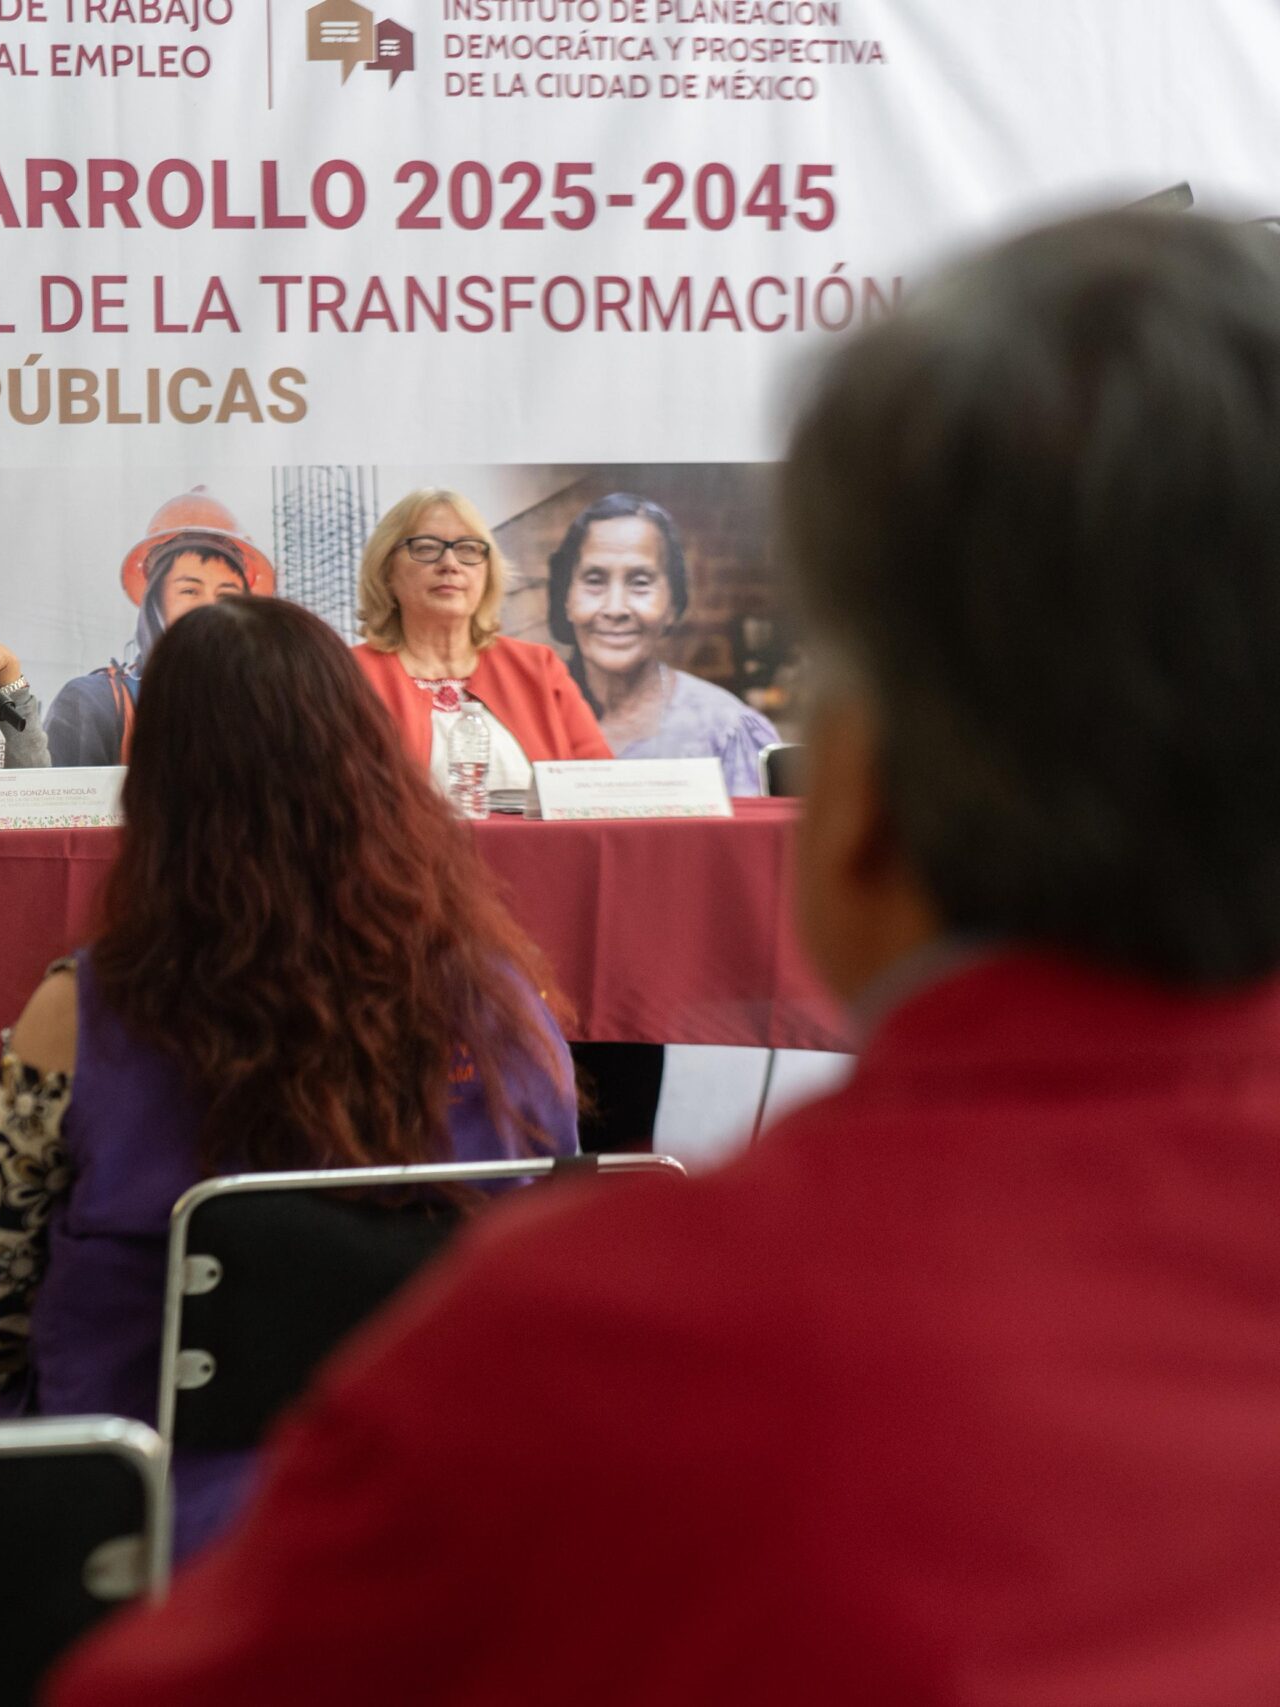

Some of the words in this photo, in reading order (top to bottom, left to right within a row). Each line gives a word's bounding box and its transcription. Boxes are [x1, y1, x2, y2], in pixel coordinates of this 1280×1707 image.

[65, 0, 235, 32] TRABAJO
[443, 0, 602, 23] INSTITUTO
[609, 0, 649, 24] DE
[51, 44, 213, 79] EMPLEO
[444, 30, 657, 62] DEMOCRÁTICA
[662, 37, 687, 62] Y
[692, 37, 888, 65] PROSPECTIVA
[445, 72, 485, 98] DE
[493, 73, 529, 98] LA
[535, 73, 651, 100] CIUDAD
[660, 74, 699, 100] DE
[706, 71, 818, 102] MÉXICO
[394, 161, 839, 233] 2025-2045
[41, 276, 130, 335] DE
[154, 276, 243, 335] LA
[260, 262, 904, 334] TRANSFORMACIÓN
